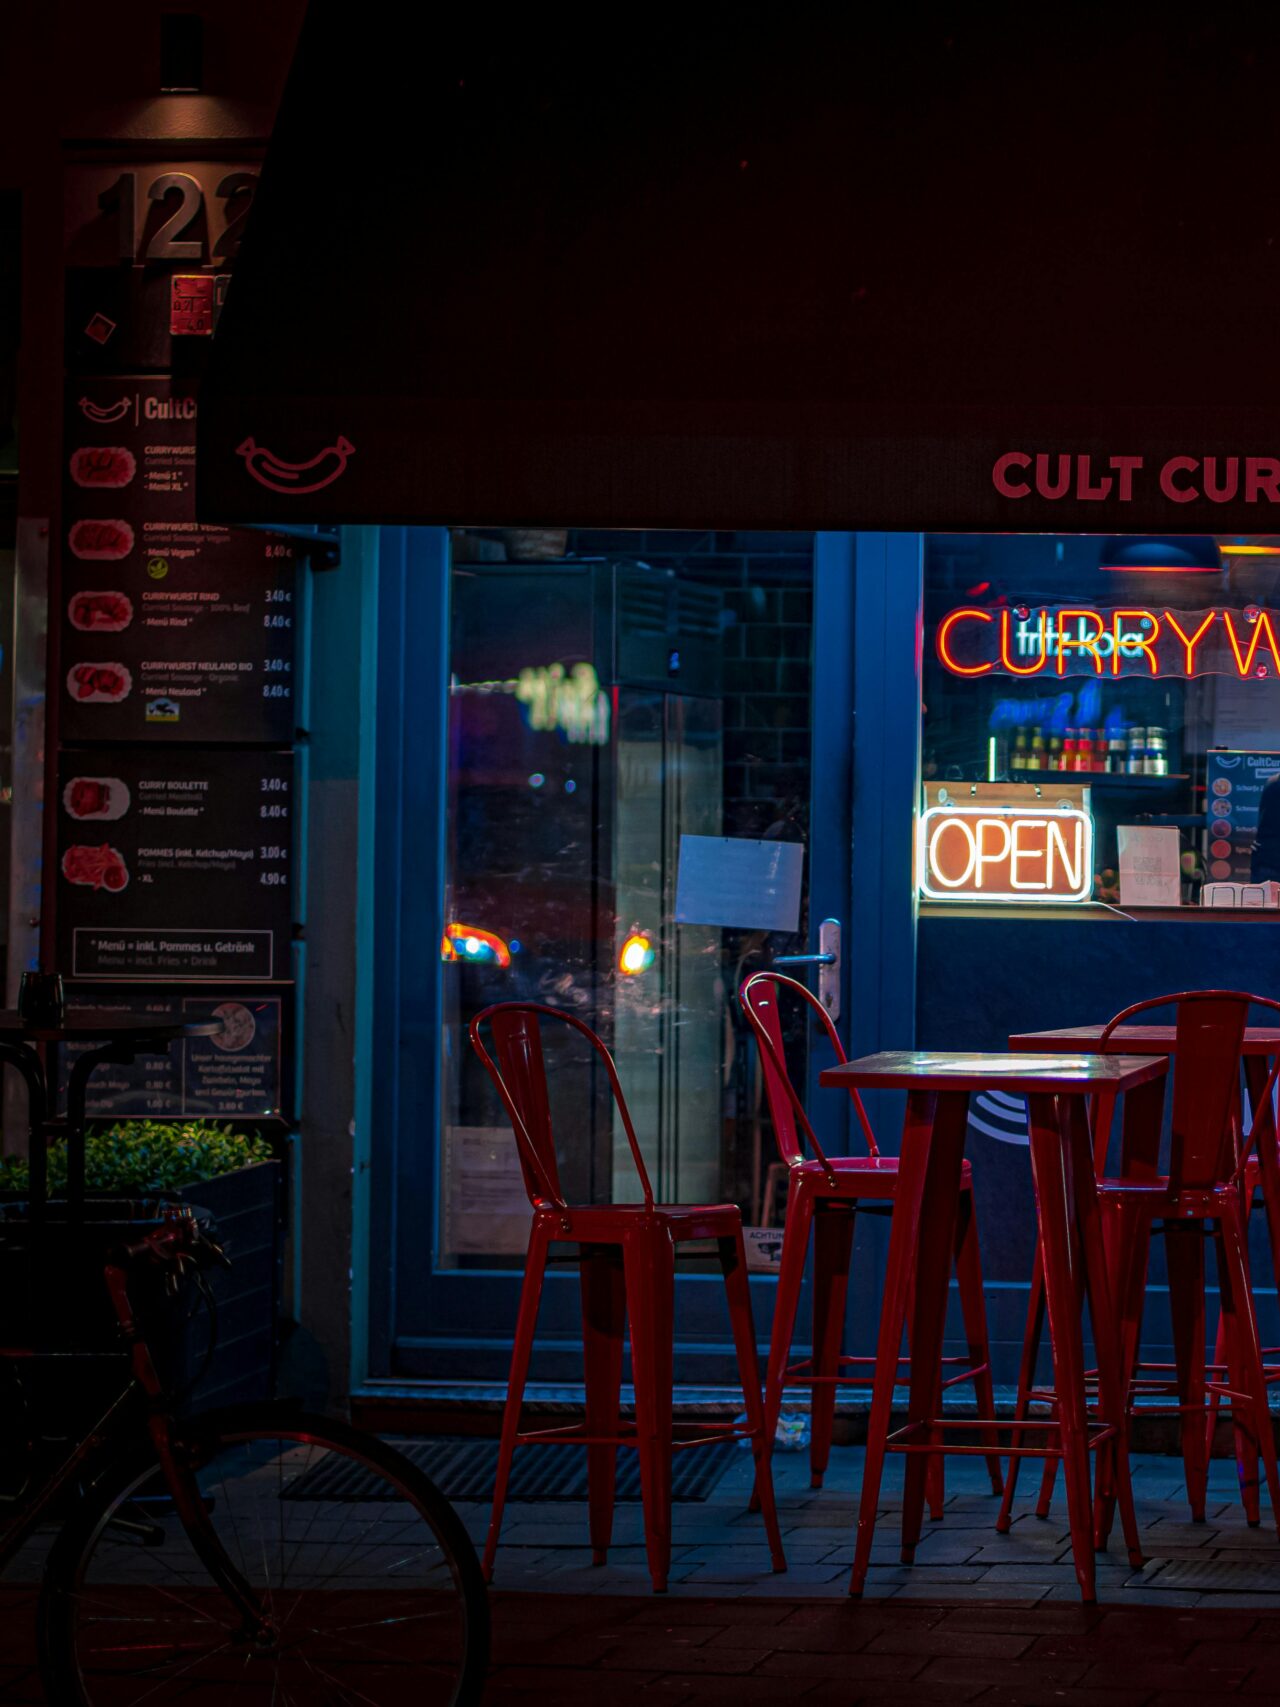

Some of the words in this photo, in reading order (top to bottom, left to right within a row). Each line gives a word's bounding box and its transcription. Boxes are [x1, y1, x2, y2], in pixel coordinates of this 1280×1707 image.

[144, 396, 197, 420] CultC
[144, 445, 197, 455] CURRYWURS
[992, 451, 1143, 501] CULT
[930, 818, 1082, 890] OPEN
[159, 941, 202, 953] Pommes
[750, 1231, 784, 1239] ACHTUN
